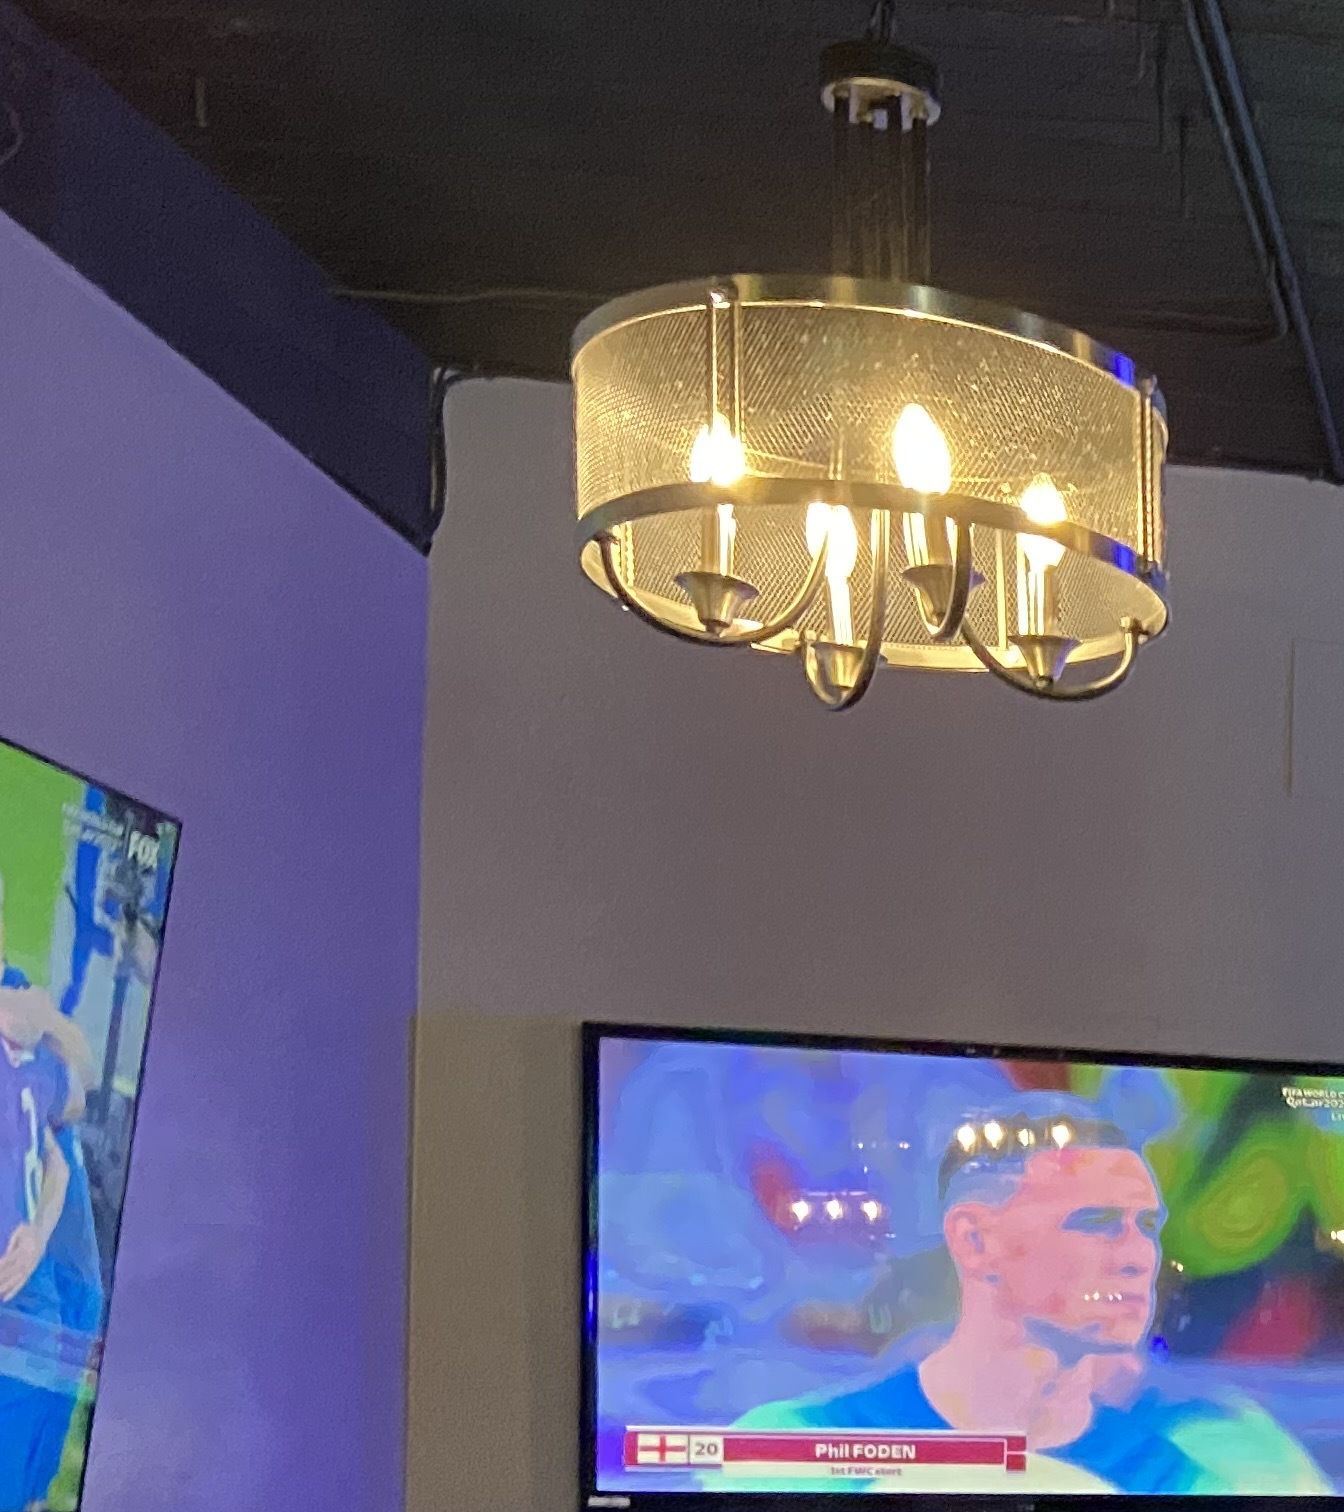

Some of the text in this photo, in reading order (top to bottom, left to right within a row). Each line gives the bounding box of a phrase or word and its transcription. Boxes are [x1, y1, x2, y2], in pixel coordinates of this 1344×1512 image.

[694, 1442, 719, 1457] 20
[814, 1443, 917, 1460] Phil FODEN
